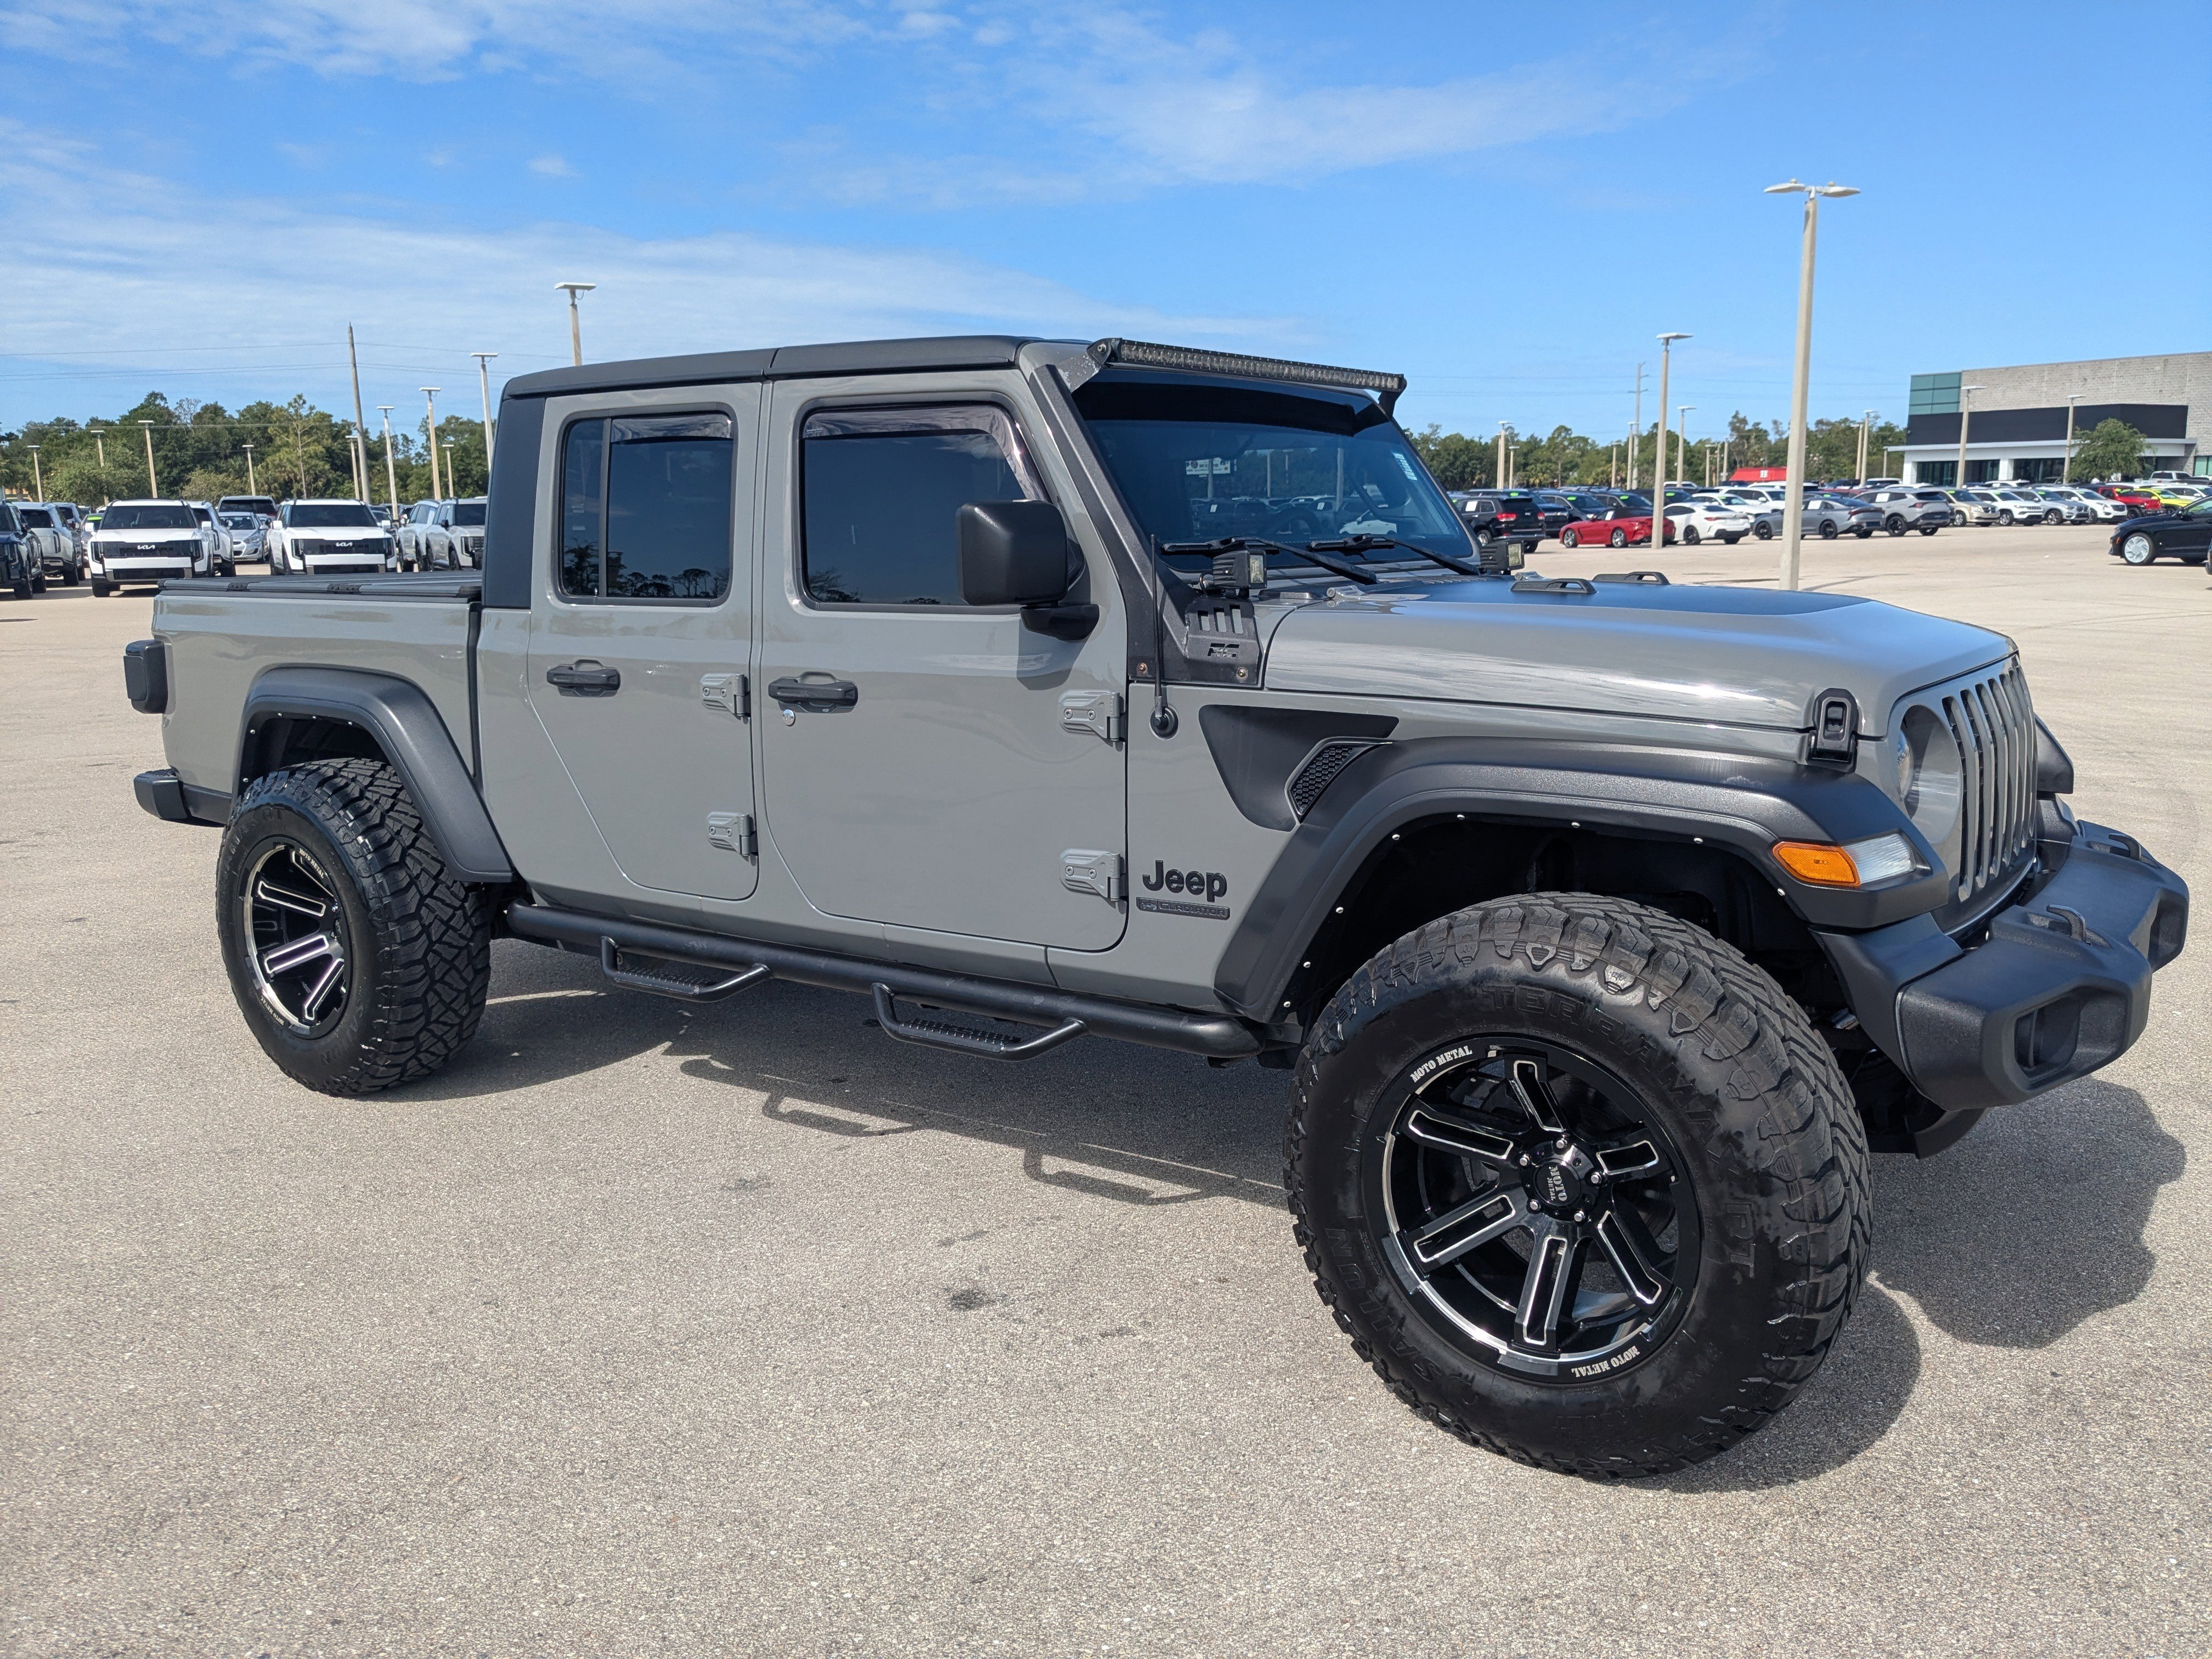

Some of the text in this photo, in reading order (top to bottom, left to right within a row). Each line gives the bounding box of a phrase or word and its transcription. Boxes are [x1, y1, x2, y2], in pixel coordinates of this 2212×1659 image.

[299, 848, 324, 878] MOTO METAL
[1142, 860, 1227, 903] Jeep
[1159, 902, 1227, 918] GLADIATOR
[1410, 1045, 1472, 1082] MOTO METAL
[1547, 1177, 1556, 1200] METAL
[1549, 1165, 1567, 1201] MOTO
[1571, 1345, 1640, 1378] MOTO METAL
